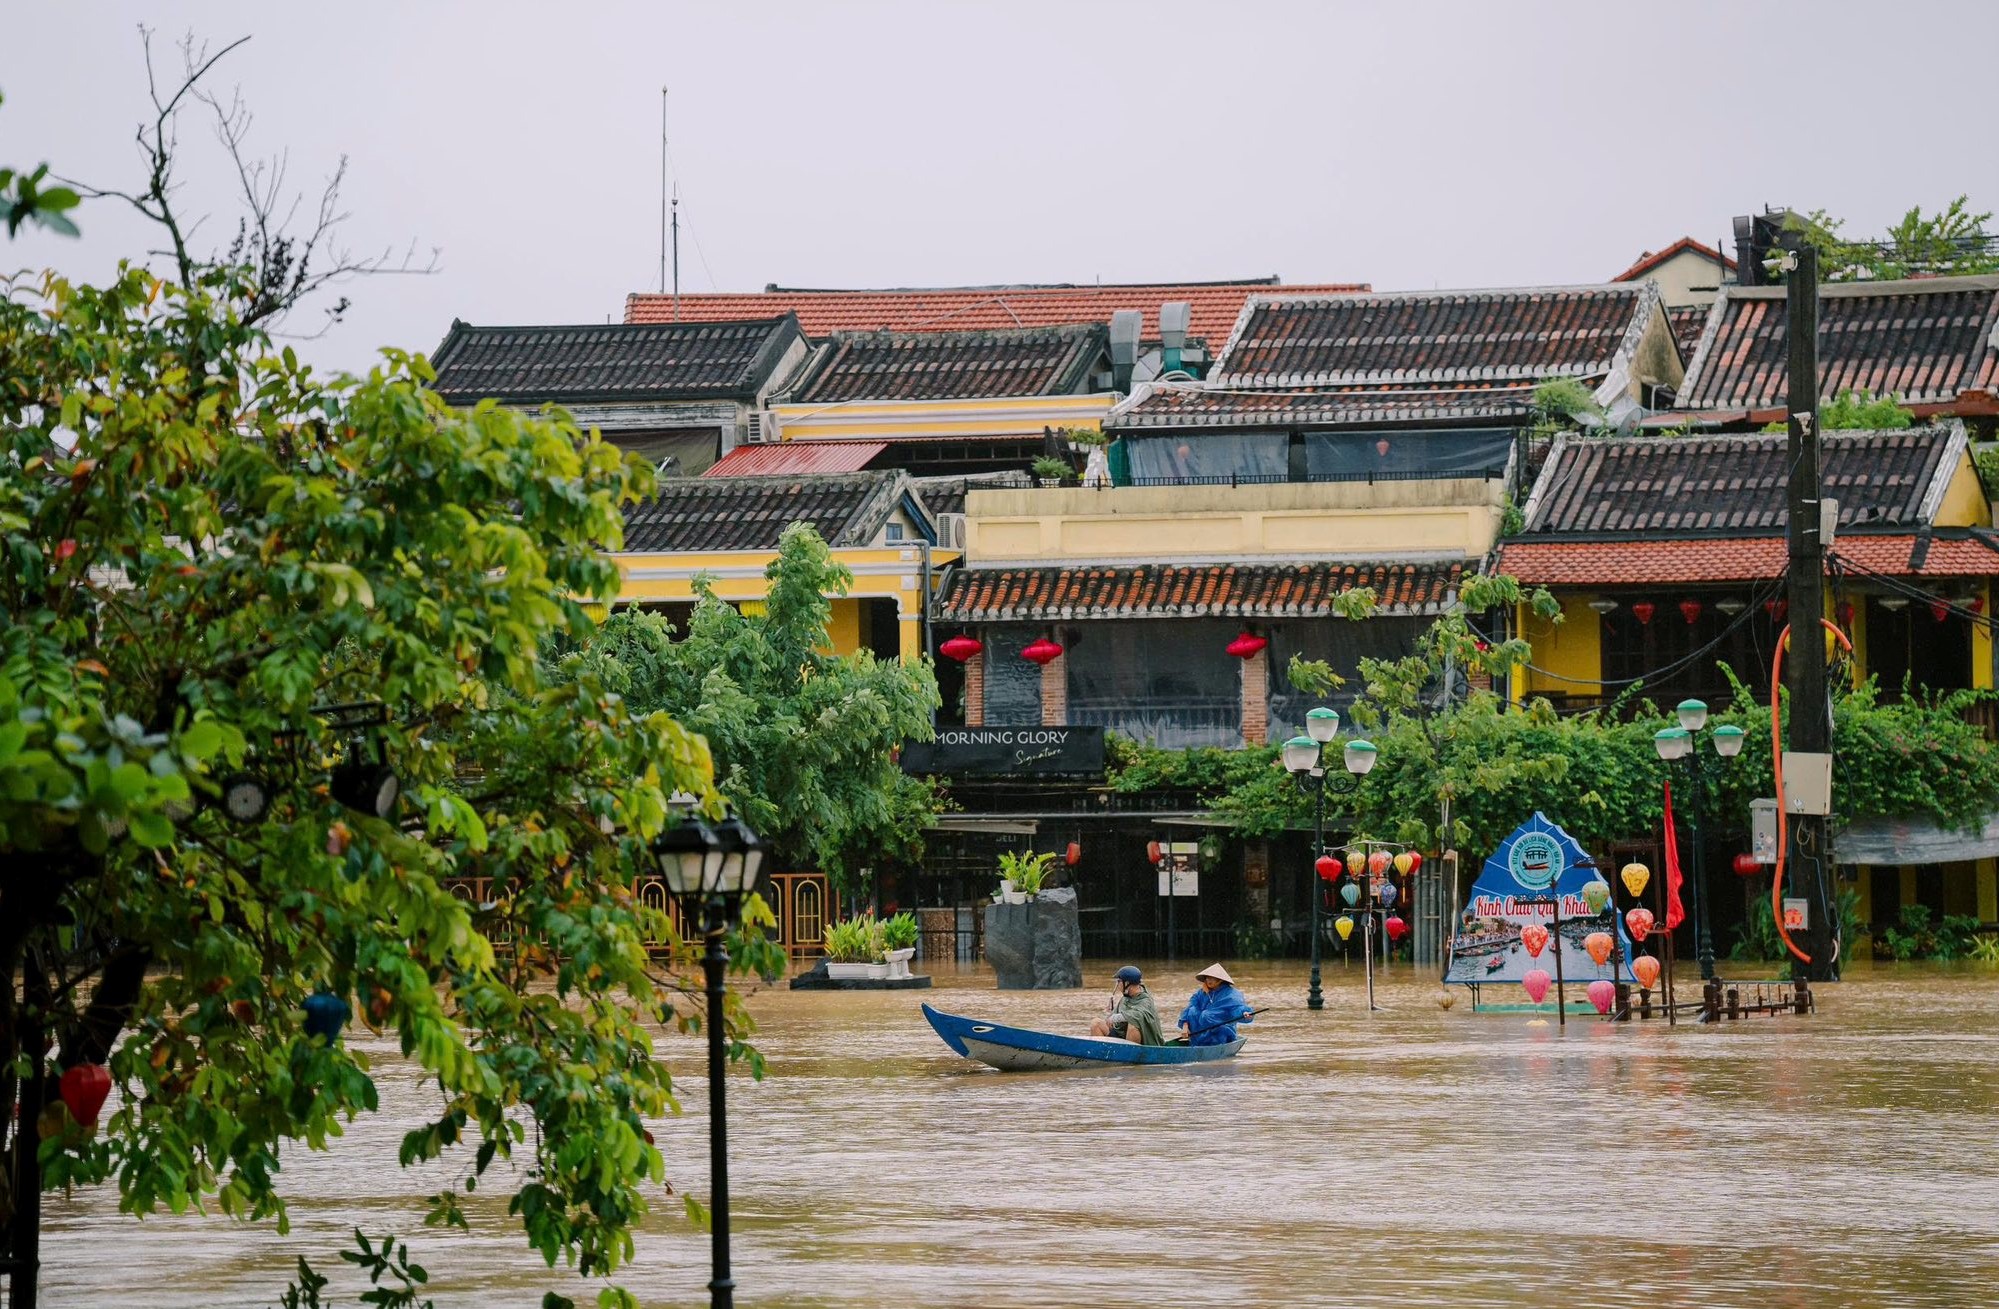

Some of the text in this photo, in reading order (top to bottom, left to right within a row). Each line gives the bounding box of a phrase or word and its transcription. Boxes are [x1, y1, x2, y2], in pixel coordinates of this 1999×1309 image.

[933, 731, 1069, 744] MORNING GLORY
[1015, 747, 1063, 765] Signature
